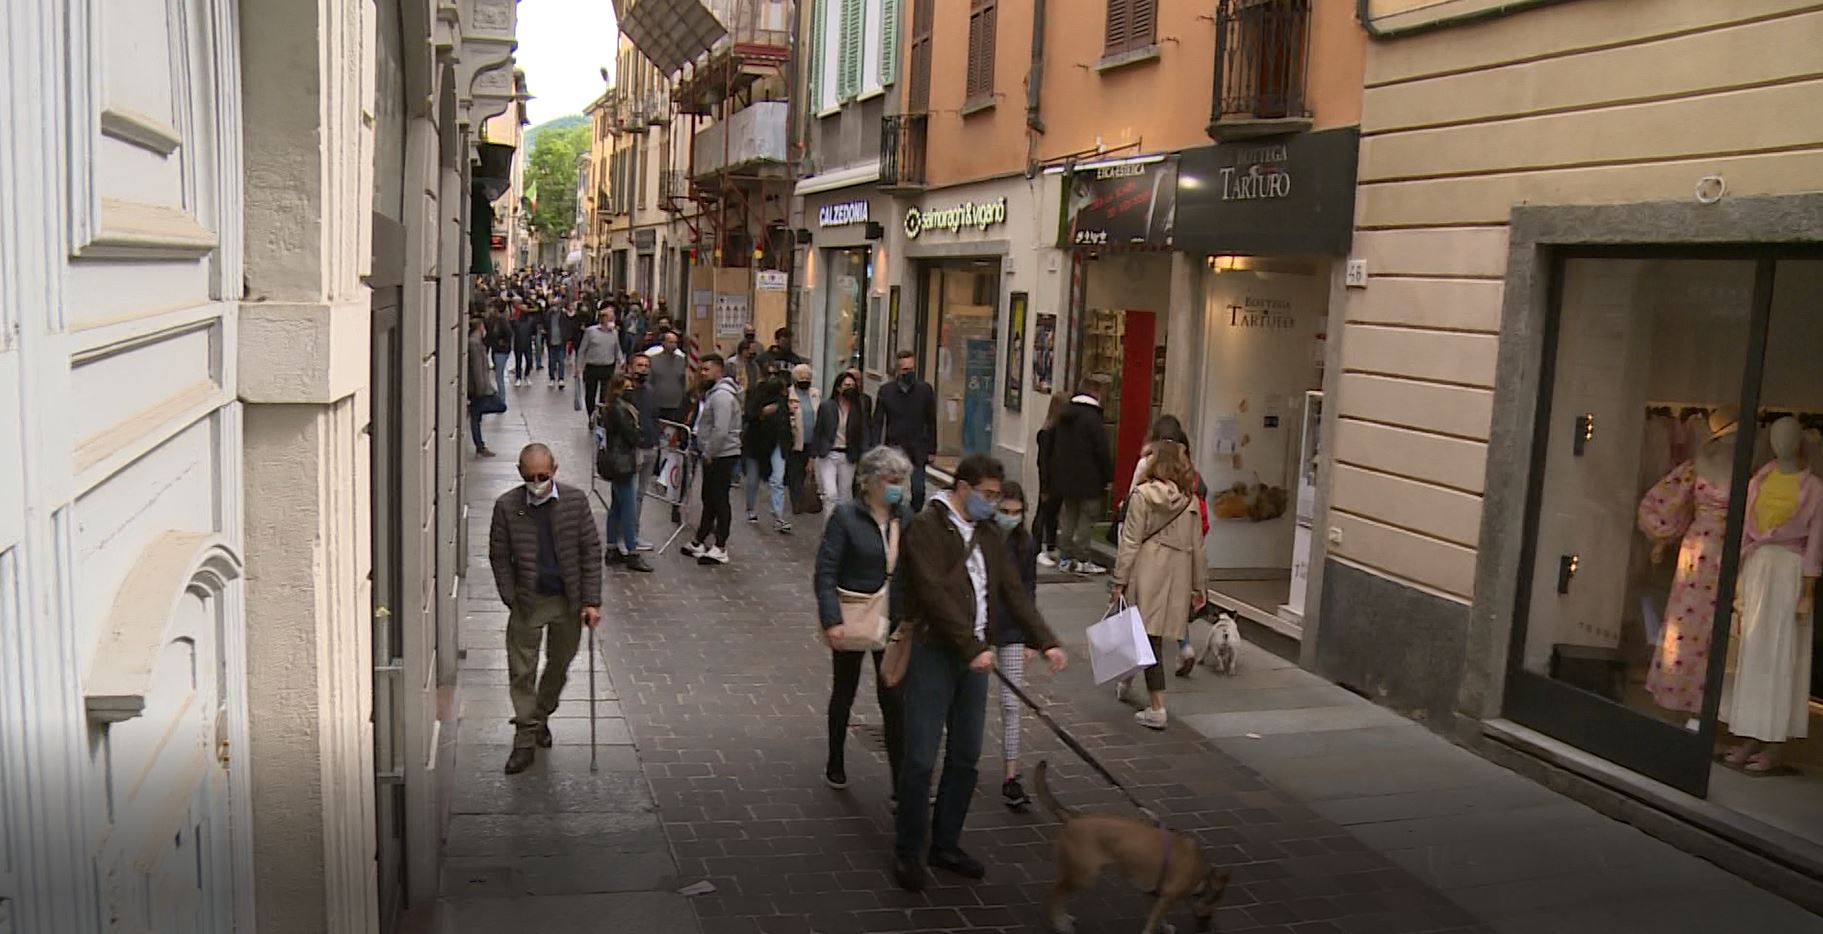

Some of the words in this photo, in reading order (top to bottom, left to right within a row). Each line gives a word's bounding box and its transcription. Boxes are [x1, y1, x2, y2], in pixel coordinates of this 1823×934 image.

[1220, 168, 1291, 200] TARTUFO
[819, 201, 869, 226] CALZEDONIA
[1348, 264, 1362, 282] 46
[1226, 304, 1295, 328] TARTUFO
